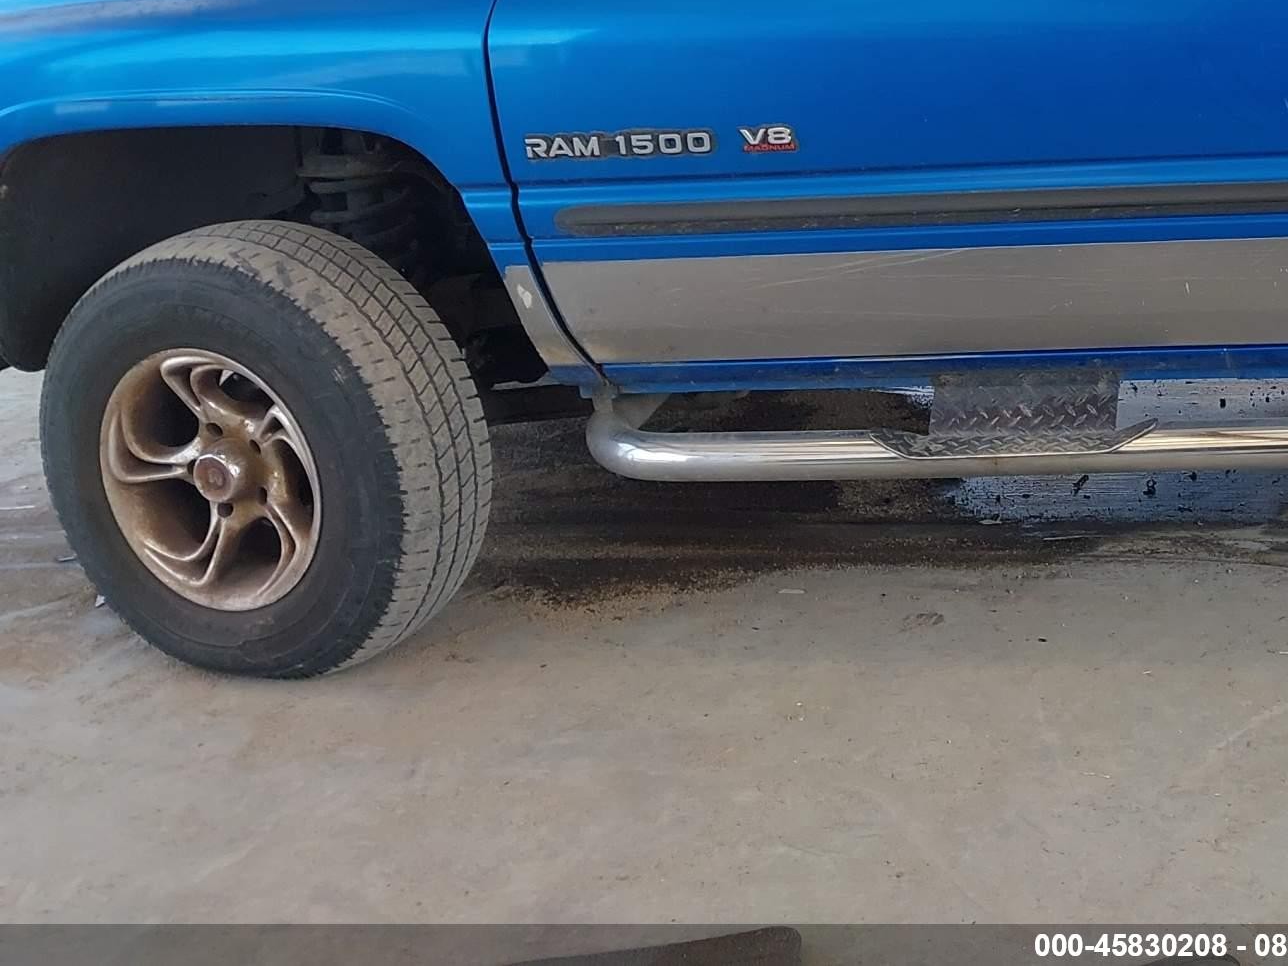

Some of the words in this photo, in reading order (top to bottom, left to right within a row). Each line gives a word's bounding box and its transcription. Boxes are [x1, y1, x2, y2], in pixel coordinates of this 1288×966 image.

[524, 136, 601, 158] RAM
[615, 132, 711, 155] 1500
[739, 127, 792, 145] V8
